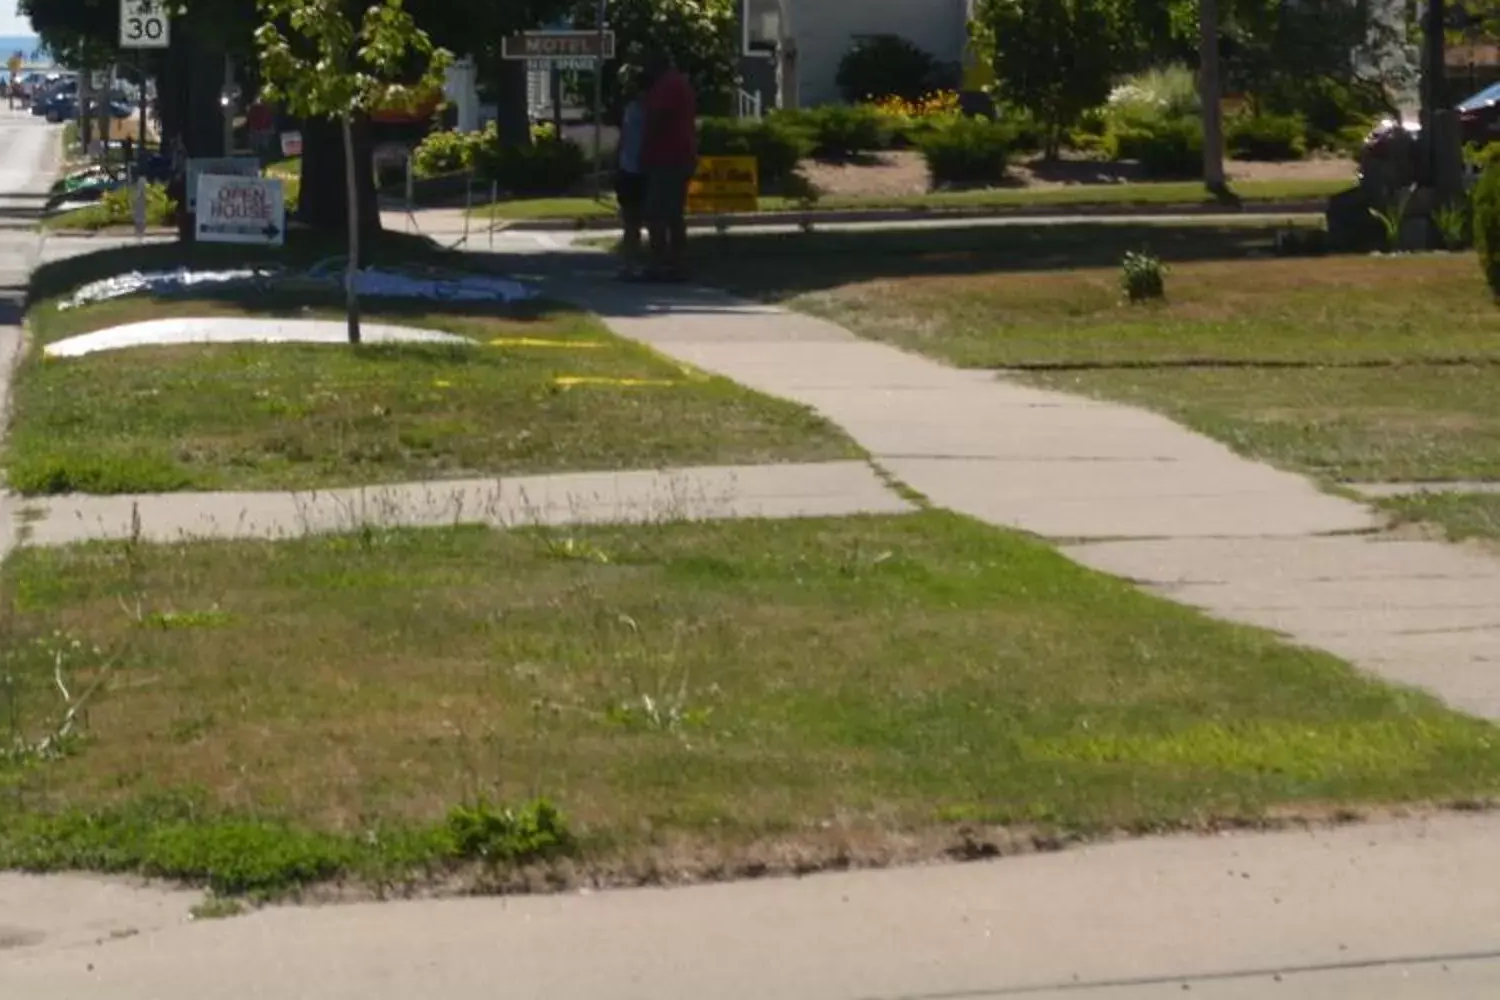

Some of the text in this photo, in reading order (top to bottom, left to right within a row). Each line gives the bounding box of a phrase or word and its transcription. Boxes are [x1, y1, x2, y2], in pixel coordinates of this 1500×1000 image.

[126, 18, 163, 39] 30
[525, 37, 590, 52] MOTEL
[217, 186, 267, 202] OPEN
[211, 200, 273, 218] HOUSE
